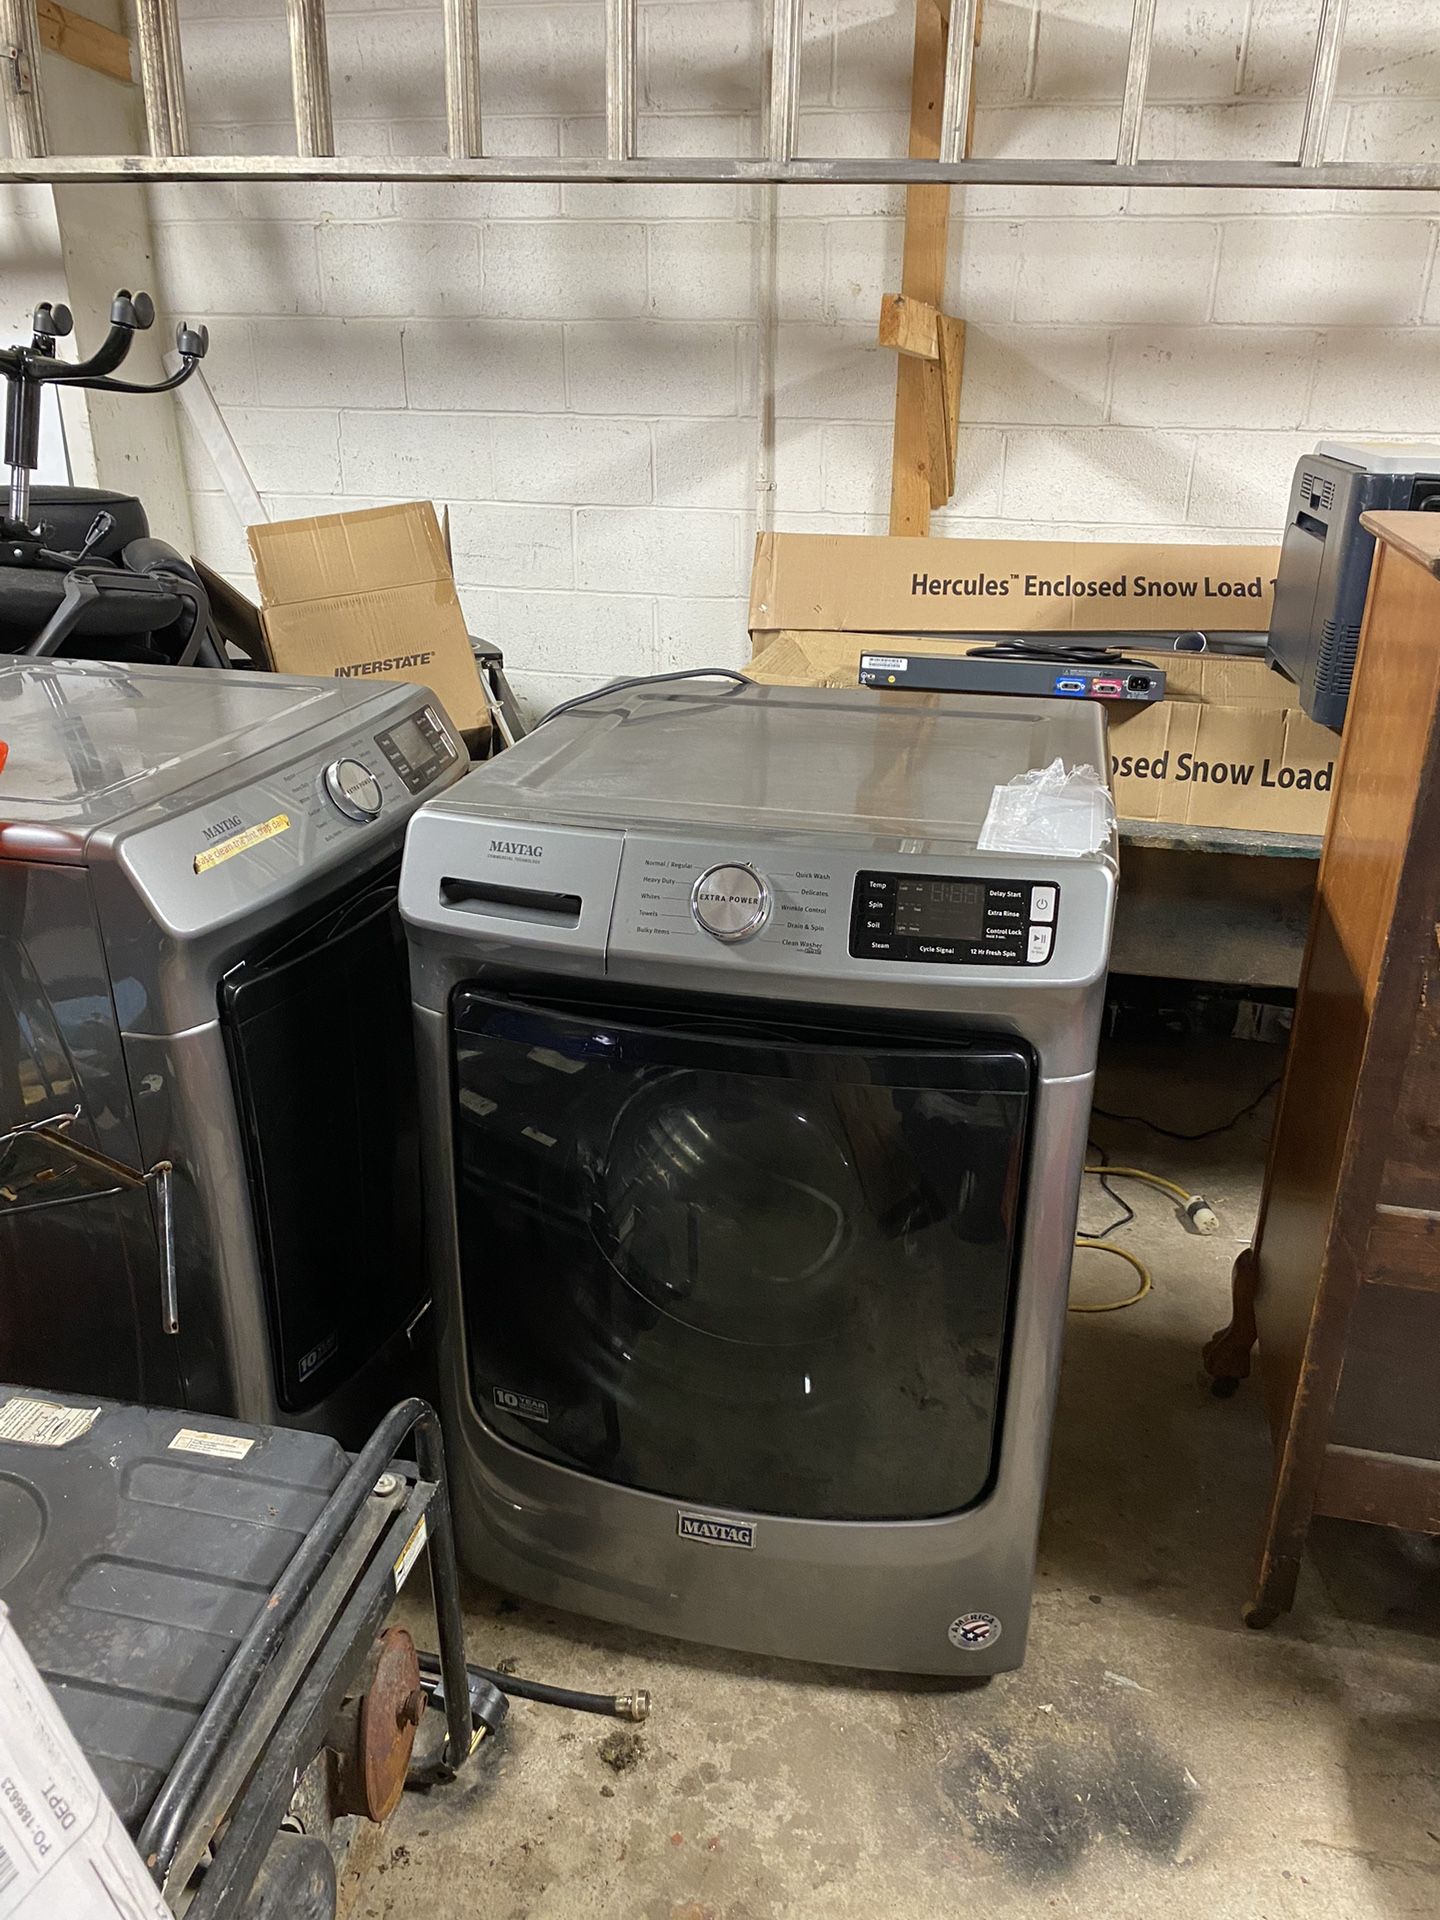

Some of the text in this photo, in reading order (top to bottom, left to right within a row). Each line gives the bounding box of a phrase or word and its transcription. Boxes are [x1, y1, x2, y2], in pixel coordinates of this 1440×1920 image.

[1023, 574, 1127, 597] Enclosed
[1133, 576, 1197, 597] Snow
[1204, 577, 1262, 598] Load
[1175, 753, 1255, 786] Snow
[1260, 759, 1334, 792] Load
[202, 815, 242, 840] MAYTAG
[489, 840, 543, 857] MAYTAG
[671, 861, 692, 869] Regular
[795, 871, 812, 879] Quick
[869, 881, 887, 889] Temp
[801, 889, 829, 897] Delicates
[989, 890, 1006, 898] Delay
[699, 894, 759, 905] EXTRA POWER
[868, 901, 883, 909] Spin
[804, 906, 827, 914] Control
[637, 926, 653, 934] Bulky
[800, 940, 823, 948] Washer
[919, 945, 955, 954] Cycle Signal
[497, 1390, 518, 1407] 10
[683, 1520, 750, 1543] MAYTAG
